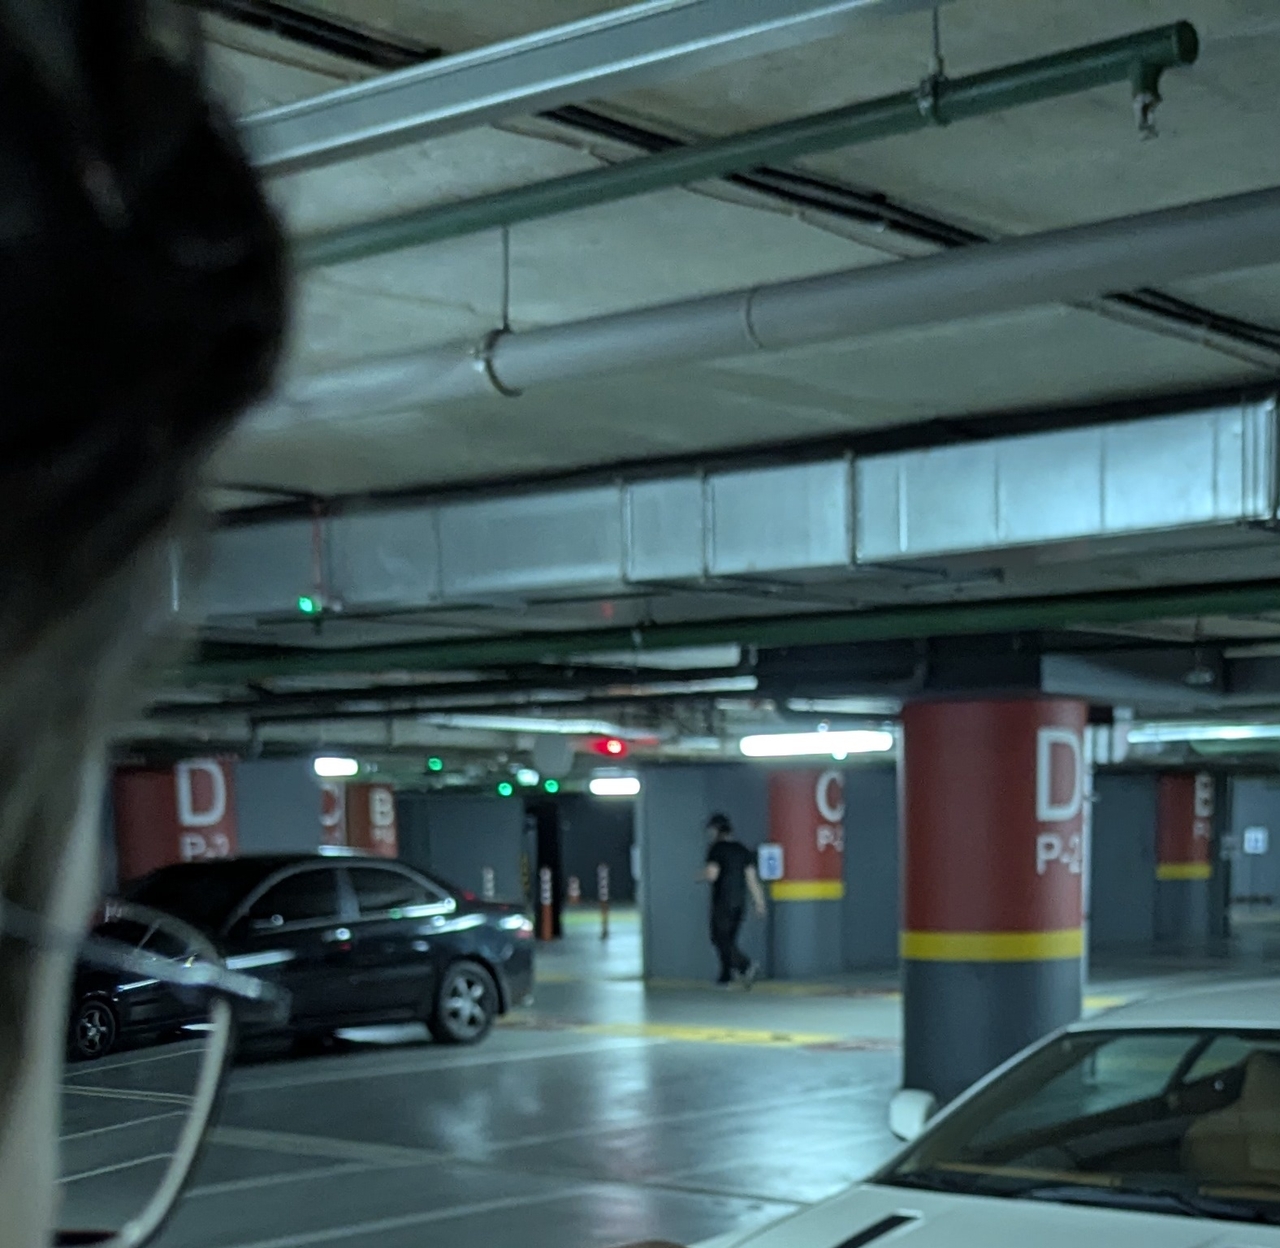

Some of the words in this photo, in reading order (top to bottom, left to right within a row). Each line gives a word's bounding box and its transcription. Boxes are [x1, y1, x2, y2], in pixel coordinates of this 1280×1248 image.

[174, 757, 226, 827] D
[816, 770, 845, 822] C
[1037, 725, 1083, 821] D
[369, 788, 395, 826] B
